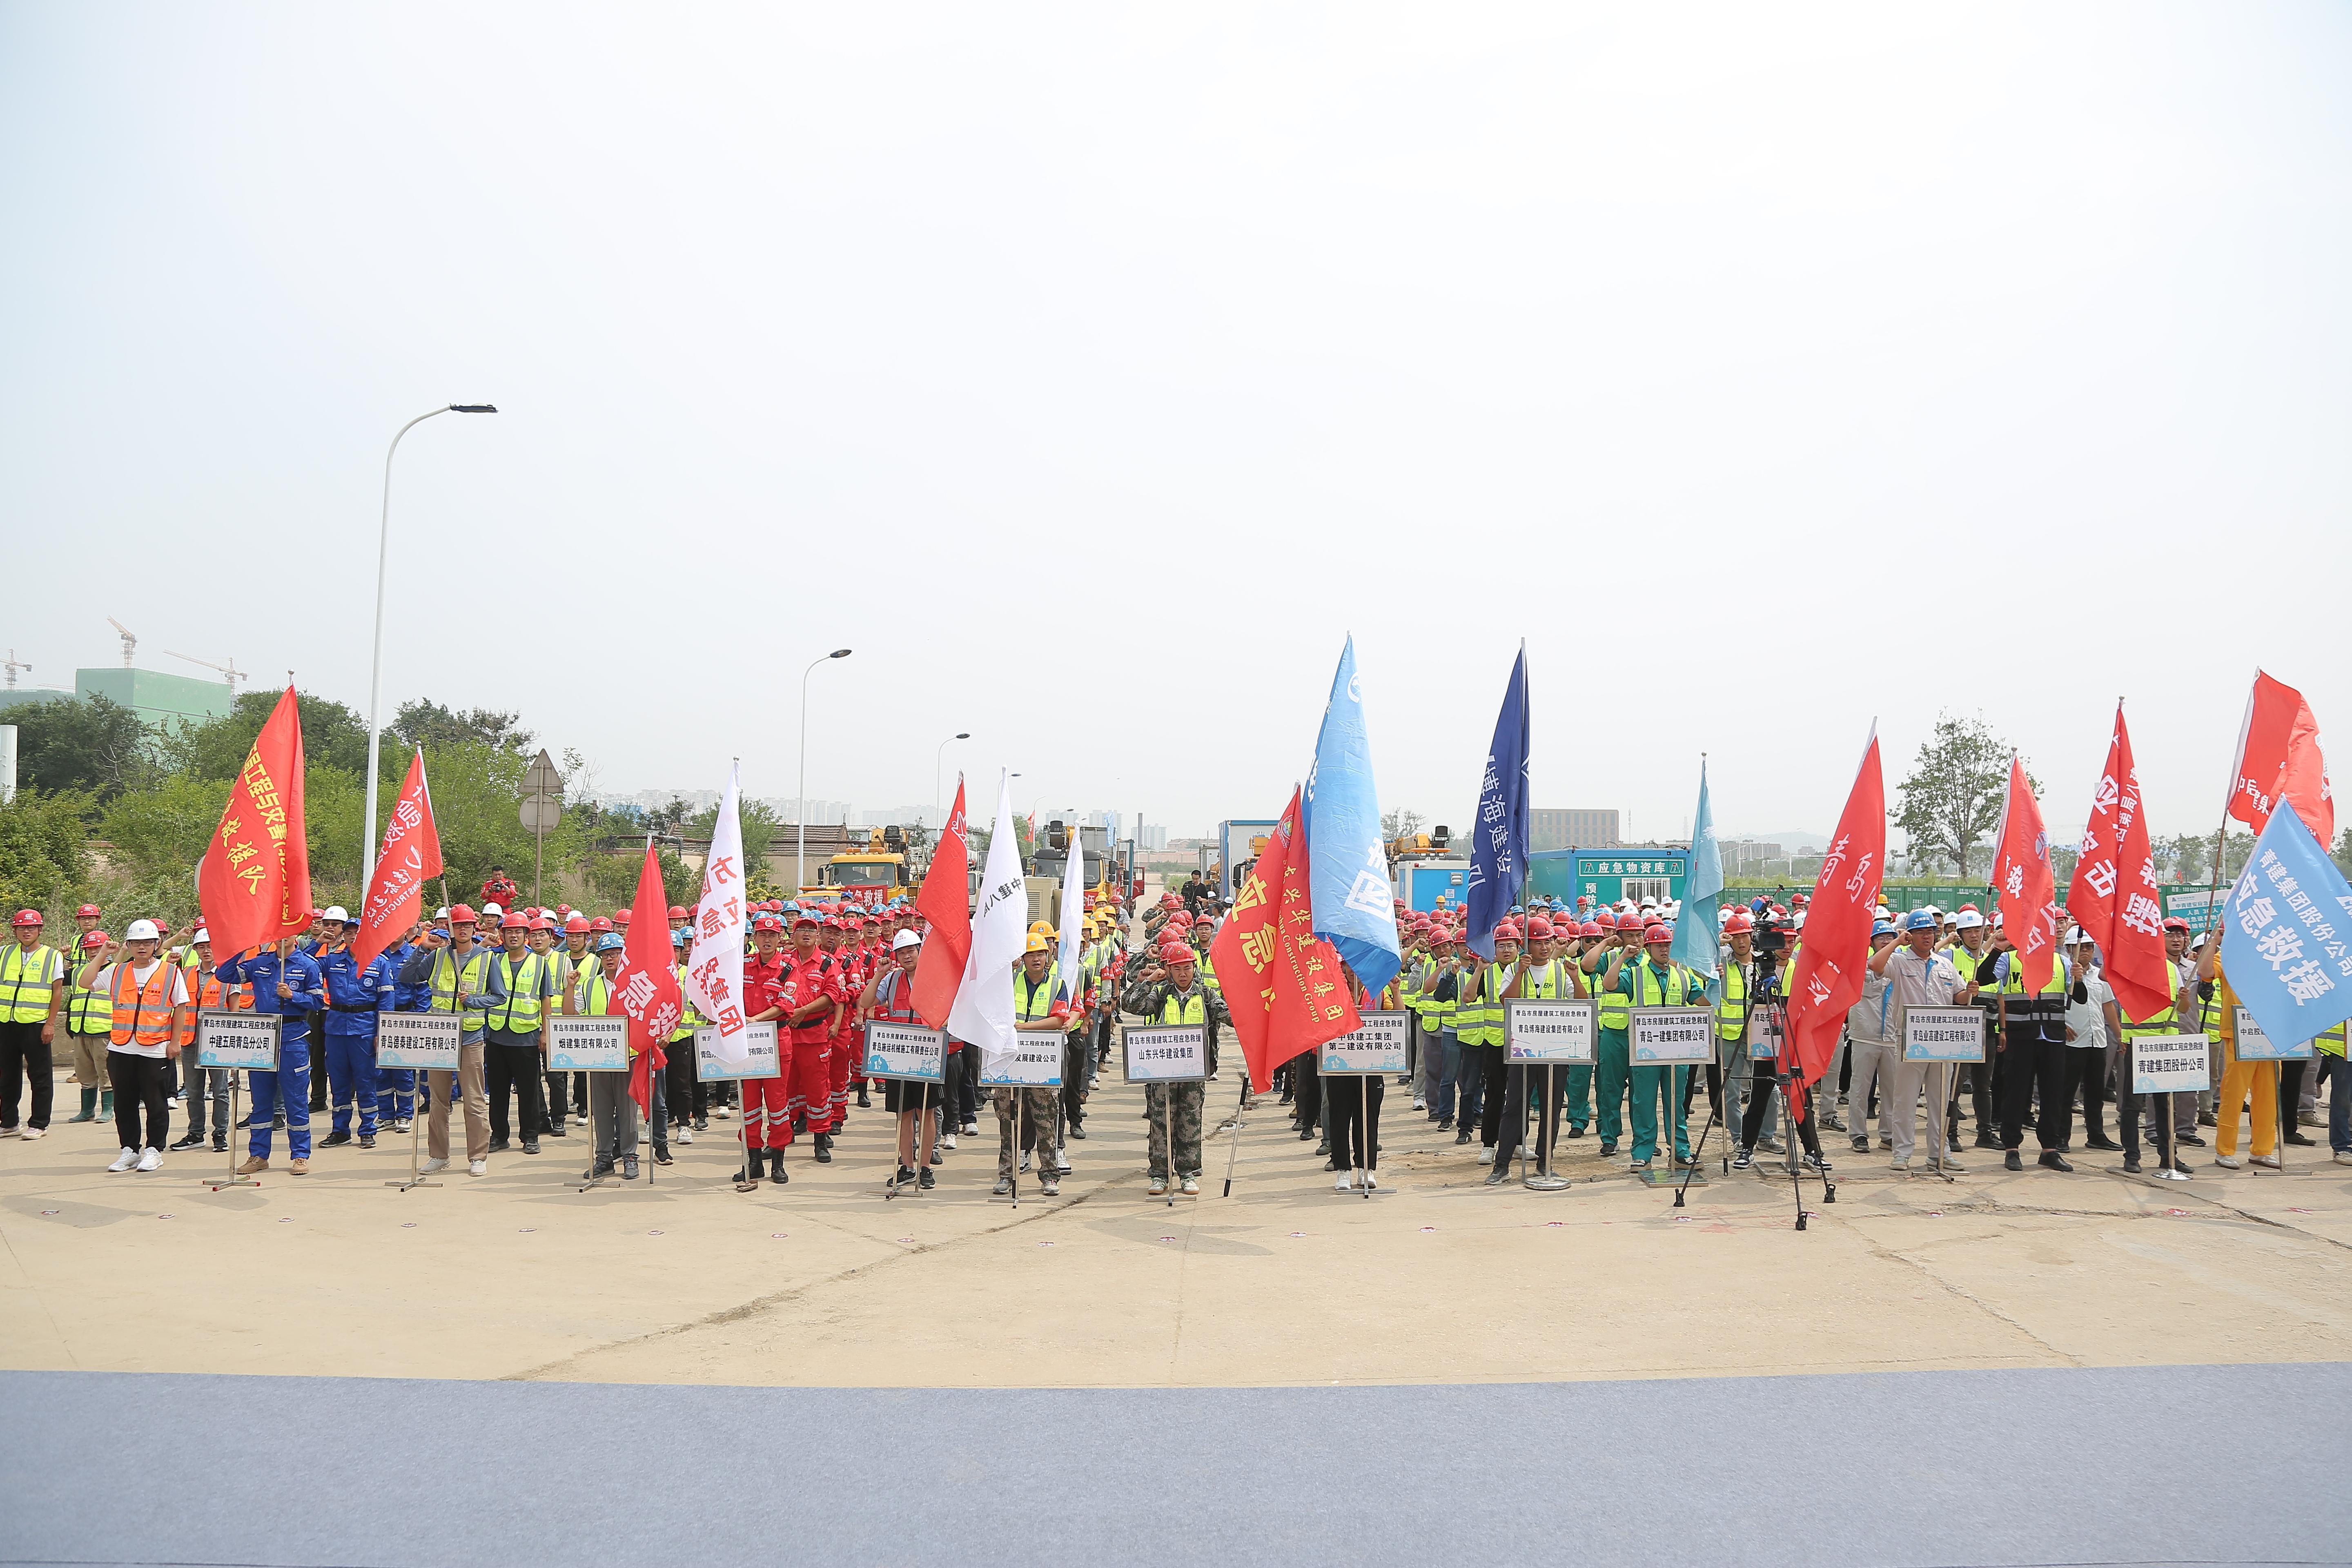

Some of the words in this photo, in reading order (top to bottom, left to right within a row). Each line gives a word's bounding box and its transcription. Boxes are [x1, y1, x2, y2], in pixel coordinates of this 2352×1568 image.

[1598, 862, 1666, 873] 应急物资库
[2176, 899, 2225, 908] 中青建安应急援队
[2259, 849, 2352, 977] 青建集团股份公司
[1232, 873, 1277, 1012] 应急
[2235, 871, 2336, 1006] 应急救援
[1282, 935, 1306, 993] Construction
[1304, 993, 1321, 1023] Group
[204, 1019, 276, 1030] 青岛市房屋建筑工程应急救援
[381, 1019, 458, 1030] 青岛市房屋建筑工程应急救援
[1636, 1016, 1708, 1026] 青岛市房屋建筑工程应急救援
[1910, 1016, 1979, 1024] 青岛市房屋建筑工程应急救援
[1518, 1024, 1584, 1034] 青岛博海建设集团有限公司
[877, 1032, 936, 1043] 青岛市房屋建筑工程应急救援
[1129, 1034, 1201, 1045] 青岛市房屋建筑工程应急救援
[1338, 1033, 1392, 1041] 中铁建工集团
[1640, 1029, 1705, 1043] 青岛一建集团有限公司
[1913, 1030, 1976, 1042] 青岛业高建设工程有限公司
[209, 1034, 269, 1050] 中建五局青岛分公司
[381, 1035, 457, 1051] 青岛德泰建设工程有限公司
[559, 1038, 618, 1049] 烟建集团有限公司
[1329, 1042, 1401, 1050] 第二建设有限公司
[2139, 1042, 2203, 1053] 青岛市房屋建筑工程应急救援
[872, 1042, 939, 1057] 青岛施运机械施工有限责任公司
[1139, 1047, 1193, 1060] 山东兴华建设集团
[2138, 1058, 2204, 1074] 青建集团股份公司
